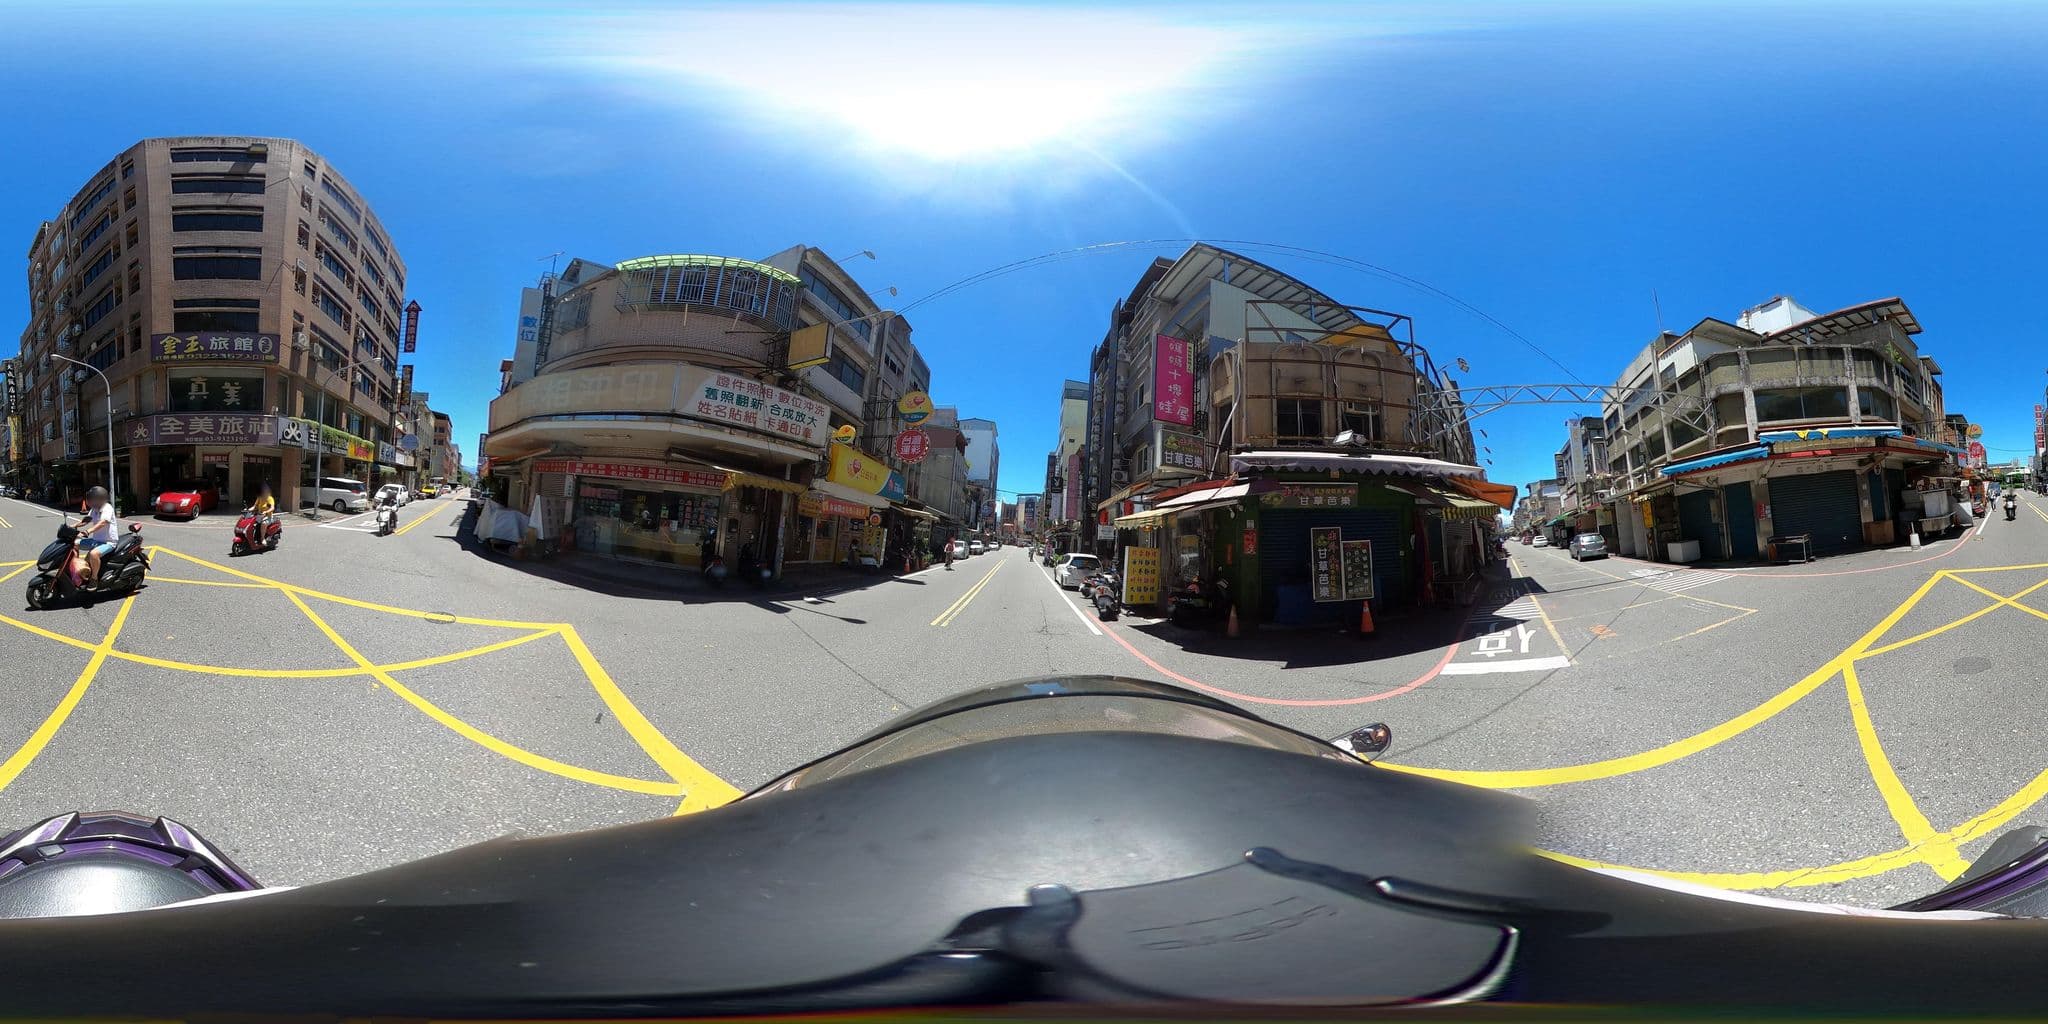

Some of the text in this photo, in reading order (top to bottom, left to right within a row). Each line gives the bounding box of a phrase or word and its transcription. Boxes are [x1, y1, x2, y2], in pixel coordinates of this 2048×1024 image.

[520, 315, 537, 342] 數位
[160, 335, 253, 354] 金玉旅館
[159, 416, 273, 435] 全美旅社
[1164, 450, 1203, 470] 甘草芭樂
[1300, 495, 1351, 506] 甘草芭樂
[1317, 547, 1330, 599] 甘草芭樂
